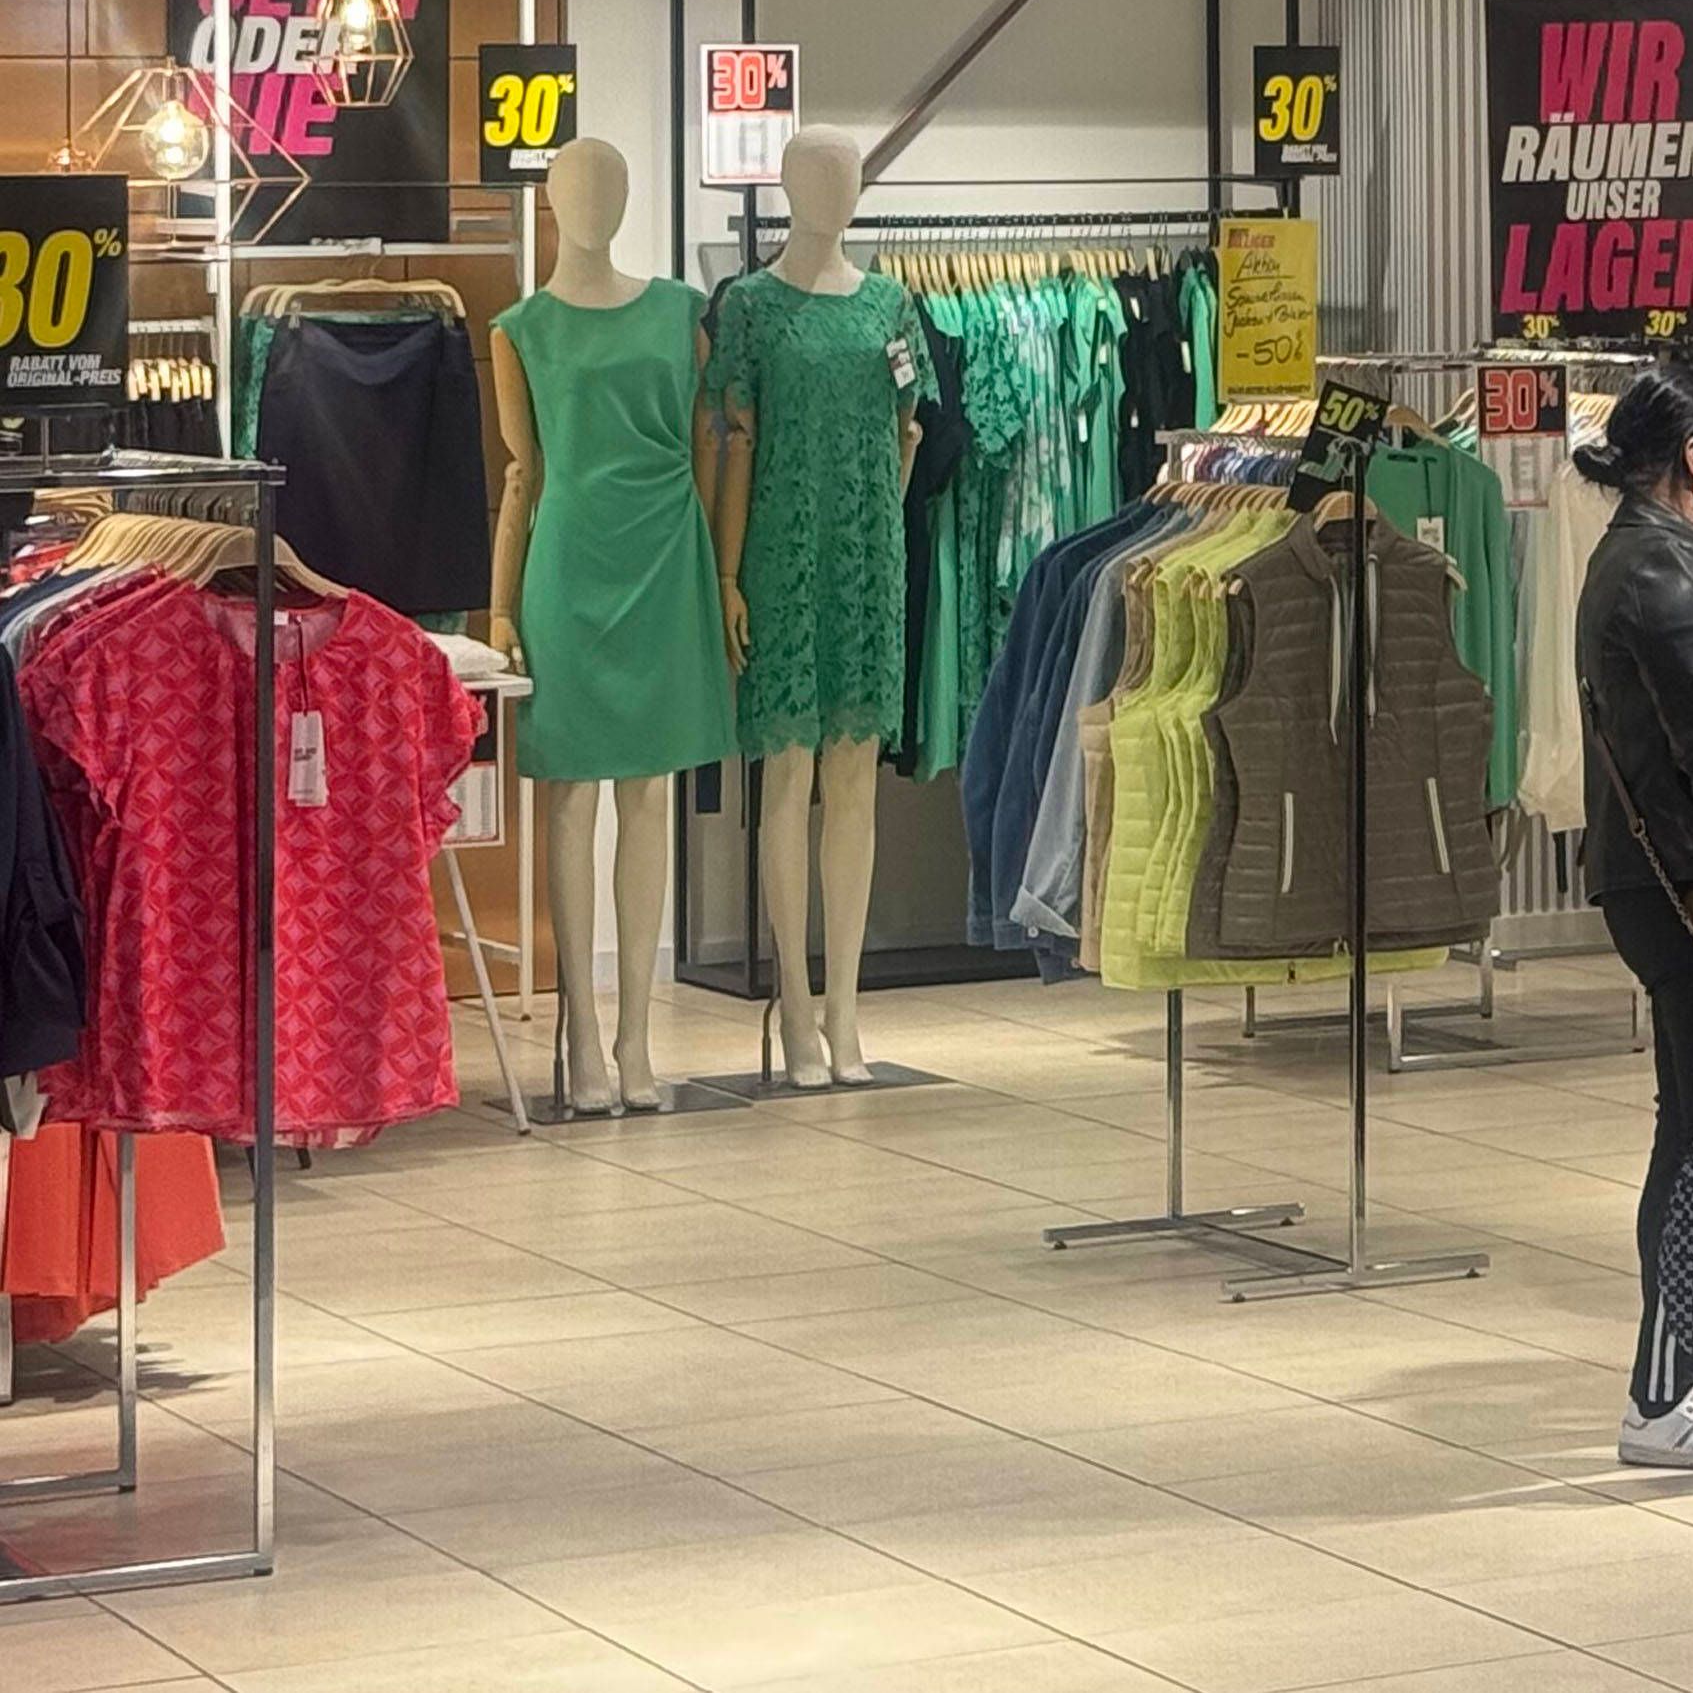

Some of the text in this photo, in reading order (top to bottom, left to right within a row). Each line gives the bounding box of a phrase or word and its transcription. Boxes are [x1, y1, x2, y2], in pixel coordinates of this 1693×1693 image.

[713, 51, 787, 109] 30%
[1539, 19, 1685, 123] WIR
[484, 74, 575, 146] 30%
[1259, 75, 1337, 141] 30%
[1566, 179, 1661, 221] UNSER
[1522, 314, 1560, 339] 30%
[1645, 309, 1687, 337] 30%
[7, 368, 122, 388] ORIGINAL-PREIS
[10, 354, 102, 372] RABATT VOM
[1320, 390, 1379, 433] 50%
[1485, 369, 1559, 431] 30%
